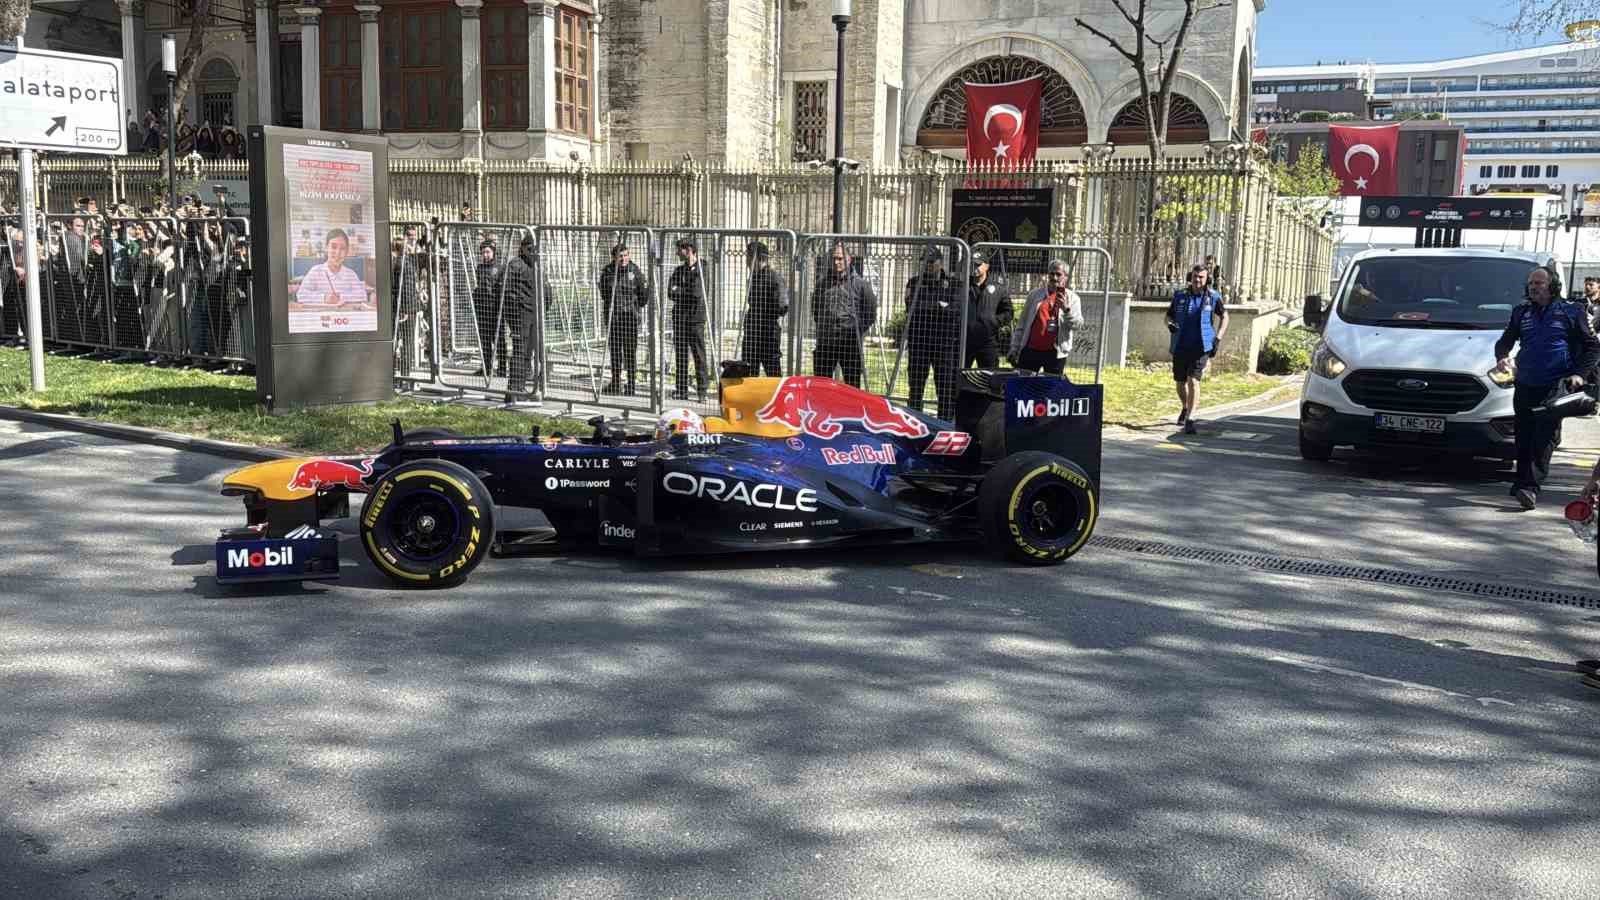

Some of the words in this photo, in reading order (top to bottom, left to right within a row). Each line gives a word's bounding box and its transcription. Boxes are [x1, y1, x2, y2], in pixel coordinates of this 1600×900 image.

[80, 134, 103, 143] 200
[1017, 399, 1069, 418] Mobil
[1382, 416, 1395, 426] 34
[1425, 418, 1443, 430] 122
[687, 433, 723, 444] ROKT
[821, 444, 865, 465] Red
[859, 443, 897, 464] Bull
[544, 458, 610, 468] CARLYLE
[560, 479, 610, 488] 1Password
[663, 472, 818, 512] ORACLE
[364, 480, 395, 529] PIRELLI
[774, 521, 804, 529] SIEMENS
[228, 546, 293, 568] Mobil
